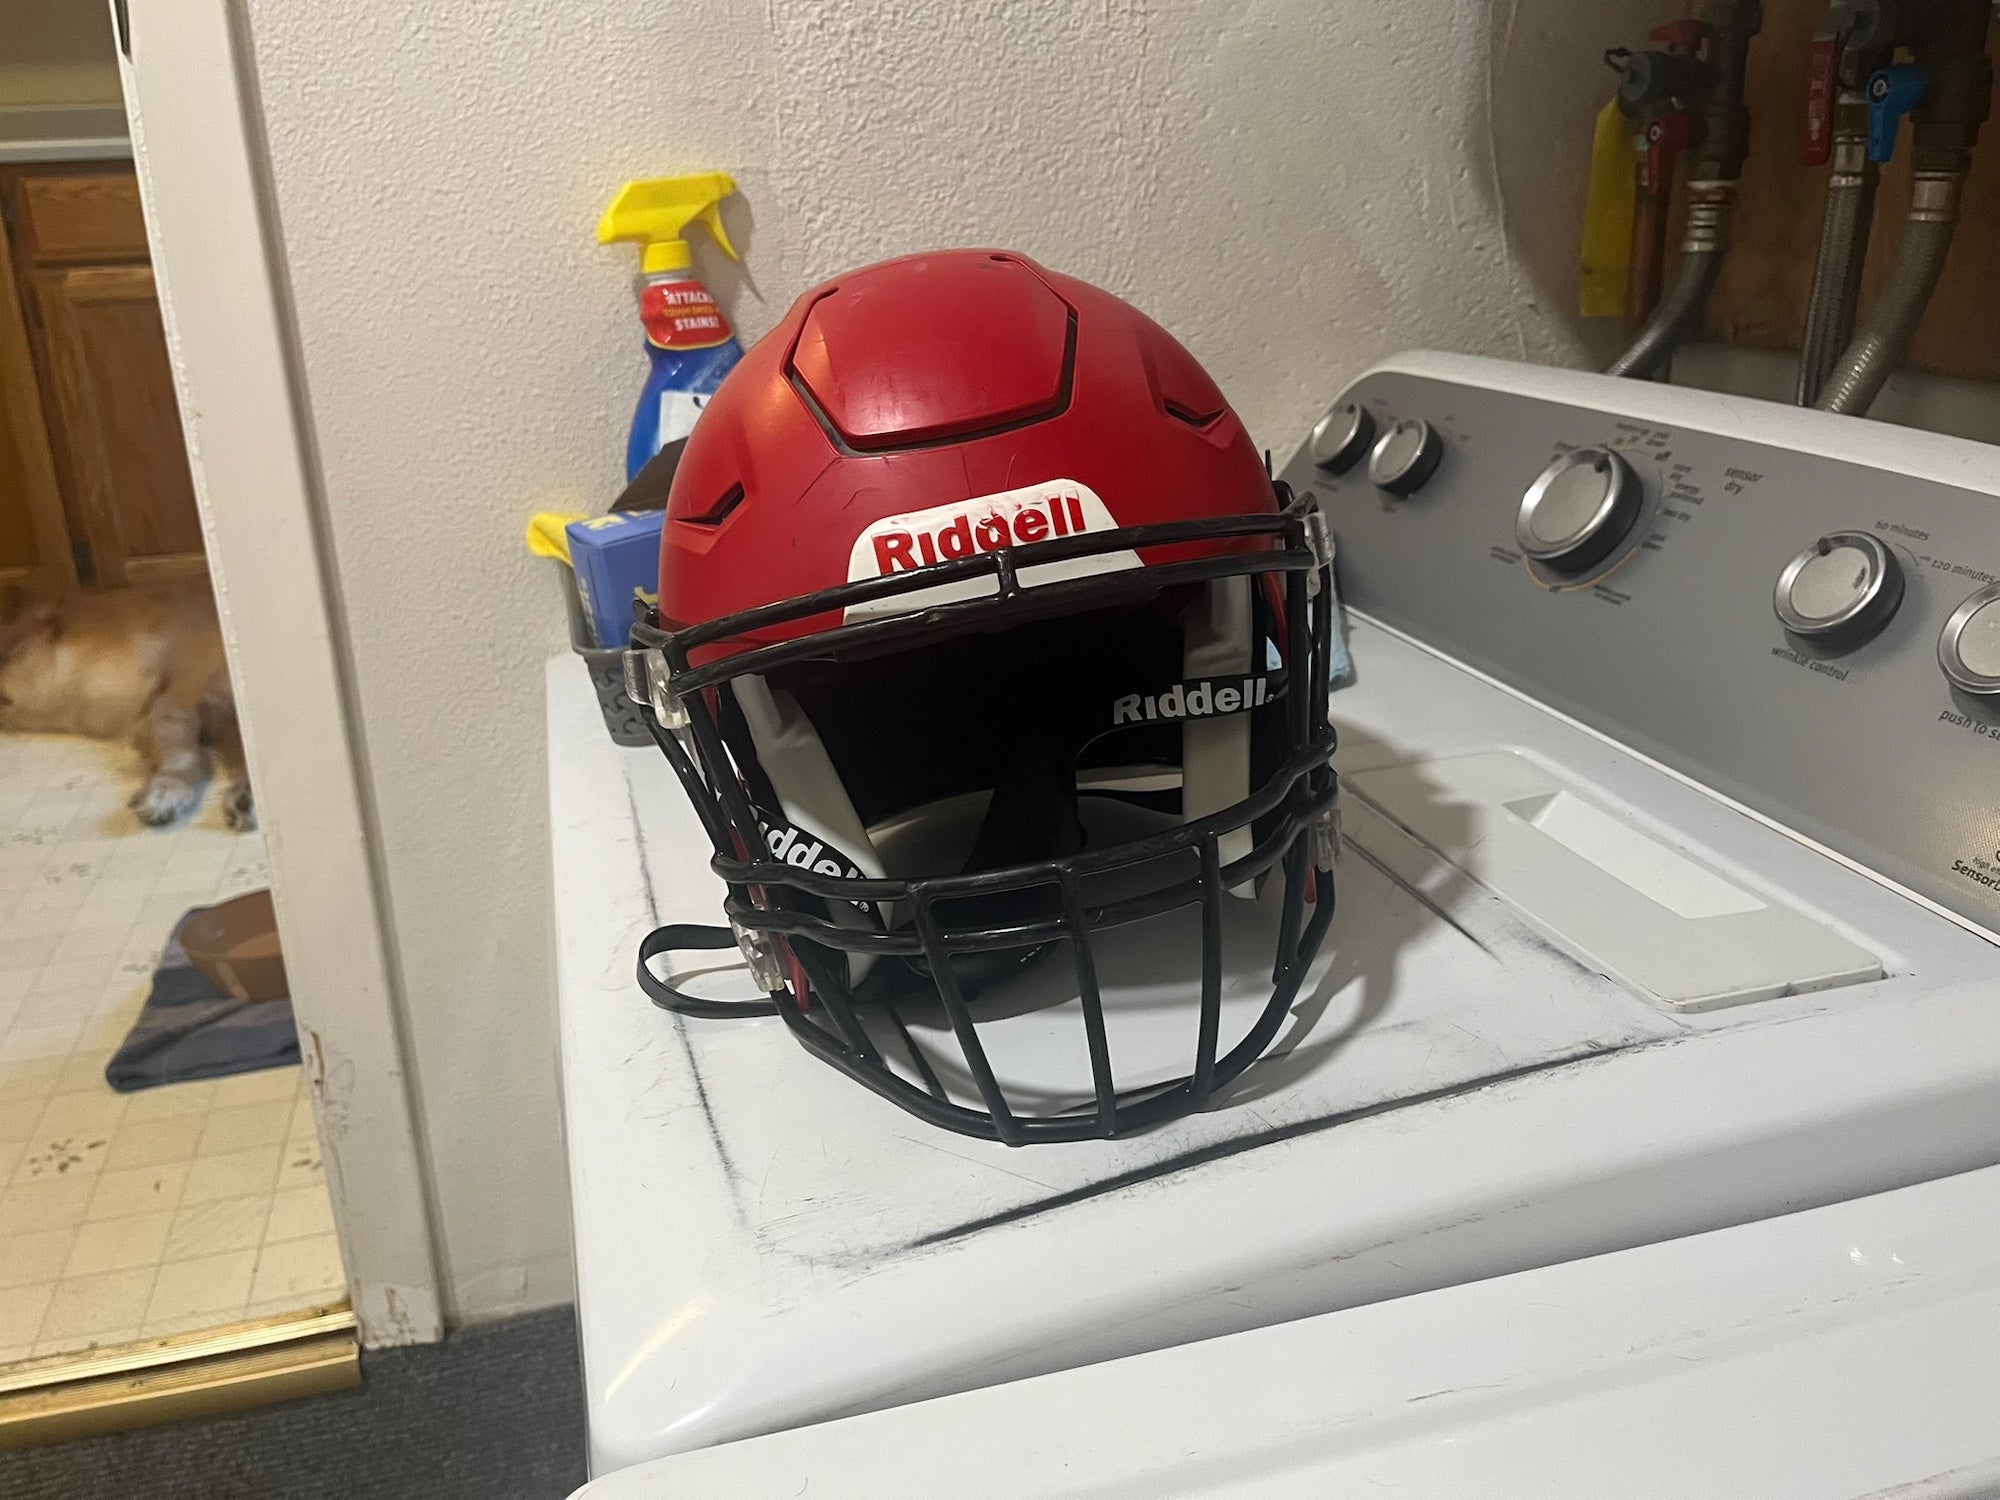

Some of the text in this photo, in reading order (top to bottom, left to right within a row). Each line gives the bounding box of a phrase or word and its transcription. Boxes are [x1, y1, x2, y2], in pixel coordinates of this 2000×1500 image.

[1724, 467, 1763, 482] sensor
[1724, 481, 1744, 496] dry
[871, 490, 1086, 577] Riddell
[1889, 524, 1930, 541] minutes
[1951, 565, 1995, 584] minutes
[1809, 661, 1850, 682] control
[1113, 677, 1267, 725] Riddell
[1938, 710, 1972, 729] push
[1973, 720, 1988, 734] to
